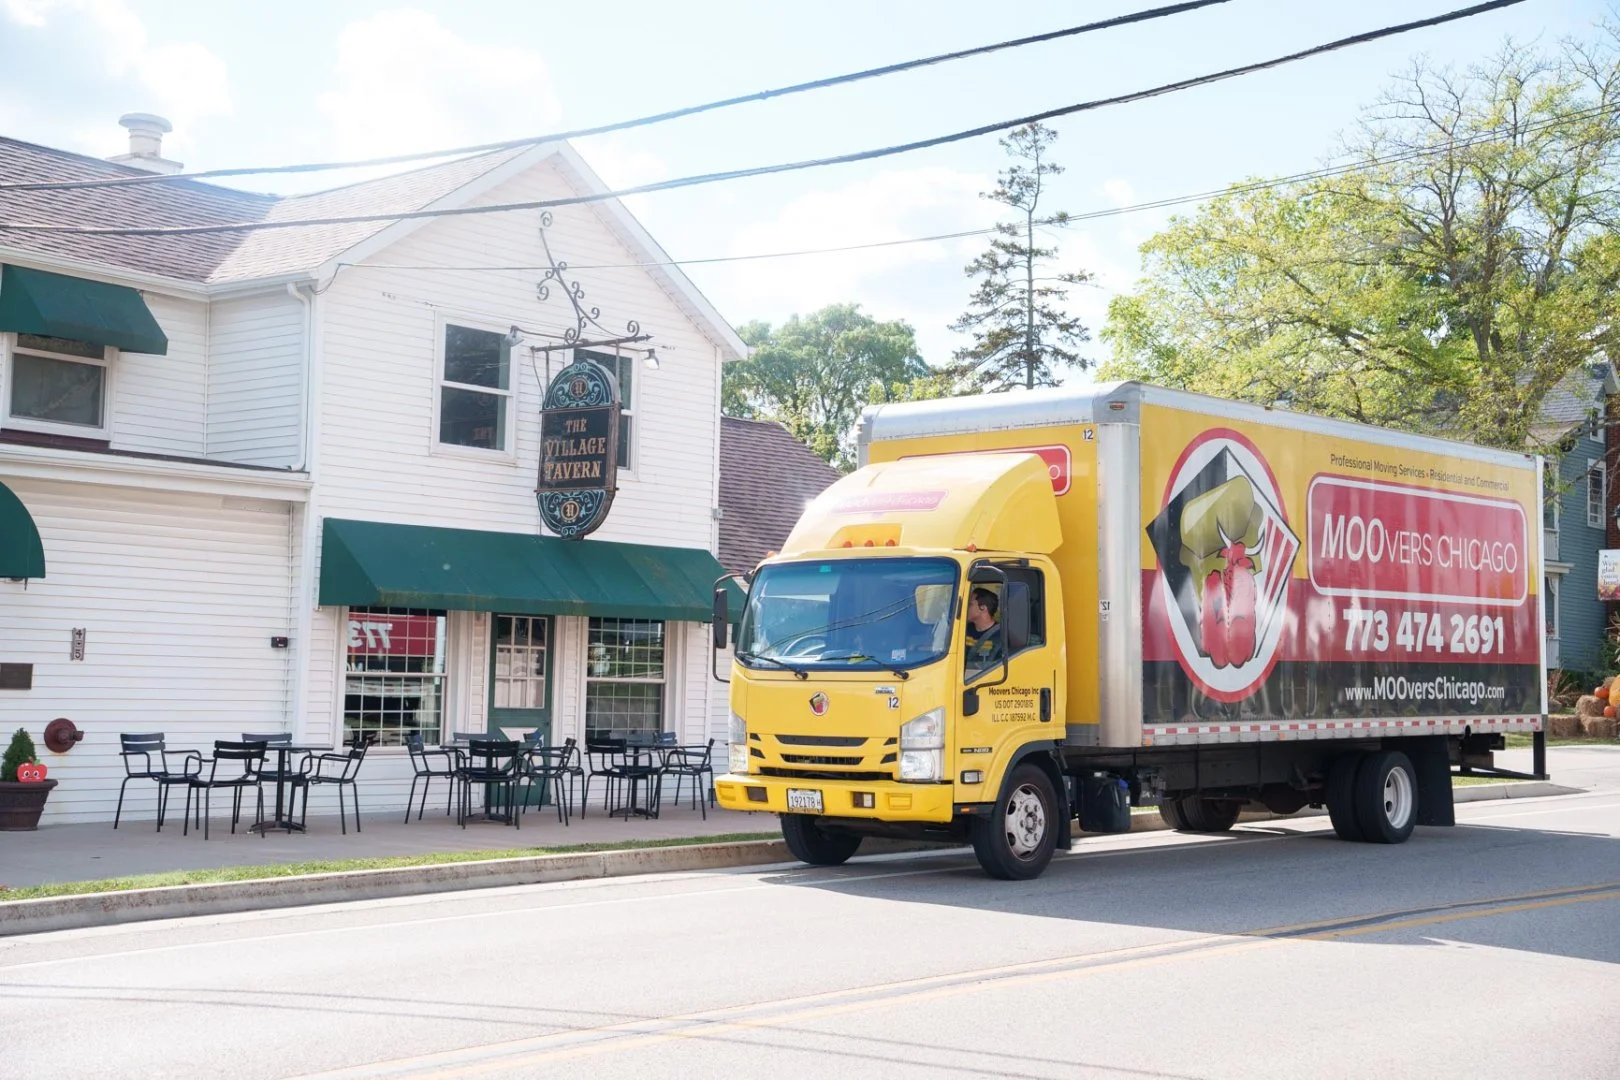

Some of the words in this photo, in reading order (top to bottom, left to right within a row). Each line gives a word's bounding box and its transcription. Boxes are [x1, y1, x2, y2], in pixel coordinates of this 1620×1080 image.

[565, 419, 587, 432] THE
[1083, 429, 1094, 440] 12
[545, 437, 606, 456] VILLAGE
[544, 461, 601, 480] TAVERN
[1330, 453, 1373, 471] Professional
[1374, 460, 1398, 478] Moving
[1399, 463, 1425, 479] Services
[1430, 468, 1463, 484] Residential
[1463, 473, 1475, 486] and
[1476, 475, 1510, 491] Commercial
[1320, 513, 1433, 566] MOOVERS
[1437, 535, 1518, 574] CHICAGO
[1343, 608, 1390, 652] 773
[1396, 611, 1444, 652] 474
[1450, 613, 1504, 654] 2691
[989, 687, 1010, 696] Moovers
[1011, 686, 1031, 697] Chicago
[1345, 676, 1505, 706] www.MOOversChicago.com
[889, 697, 899, 708] 12
